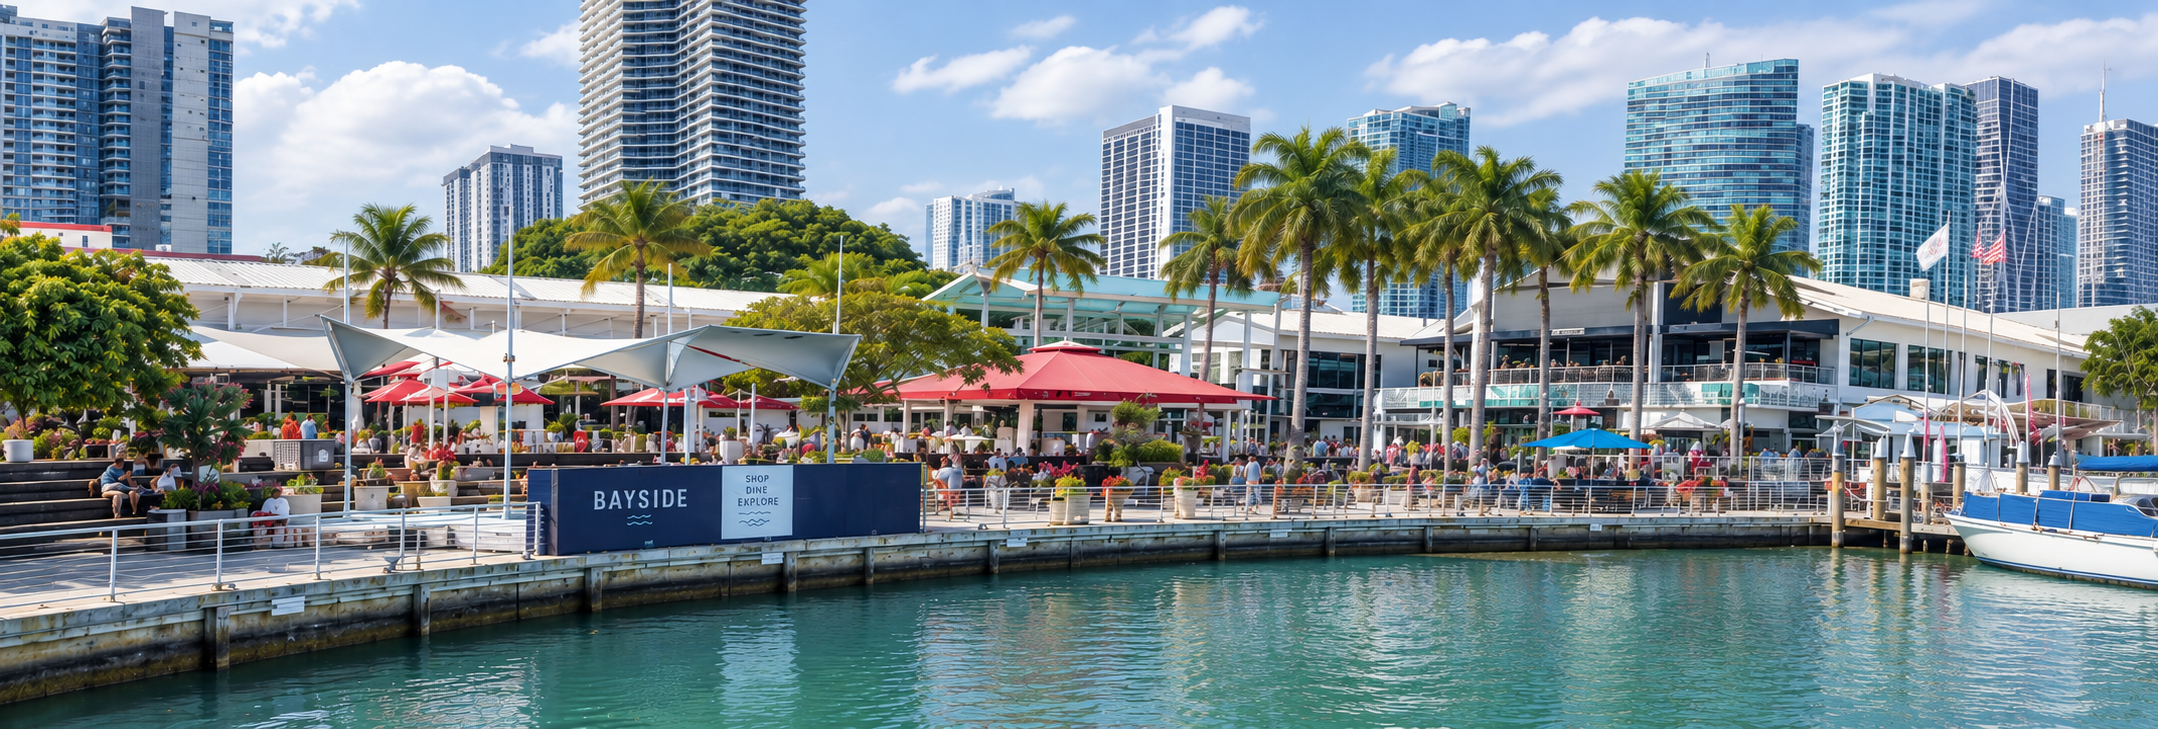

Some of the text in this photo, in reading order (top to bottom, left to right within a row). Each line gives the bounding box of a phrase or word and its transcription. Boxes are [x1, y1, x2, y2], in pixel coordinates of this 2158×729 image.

[745, 474, 769, 483] SHOP
[746, 485, 768, 494] DINE
[594, 488, 687, 510] BAYSIDE
[737, 497, 779, 506] EXPLORE
